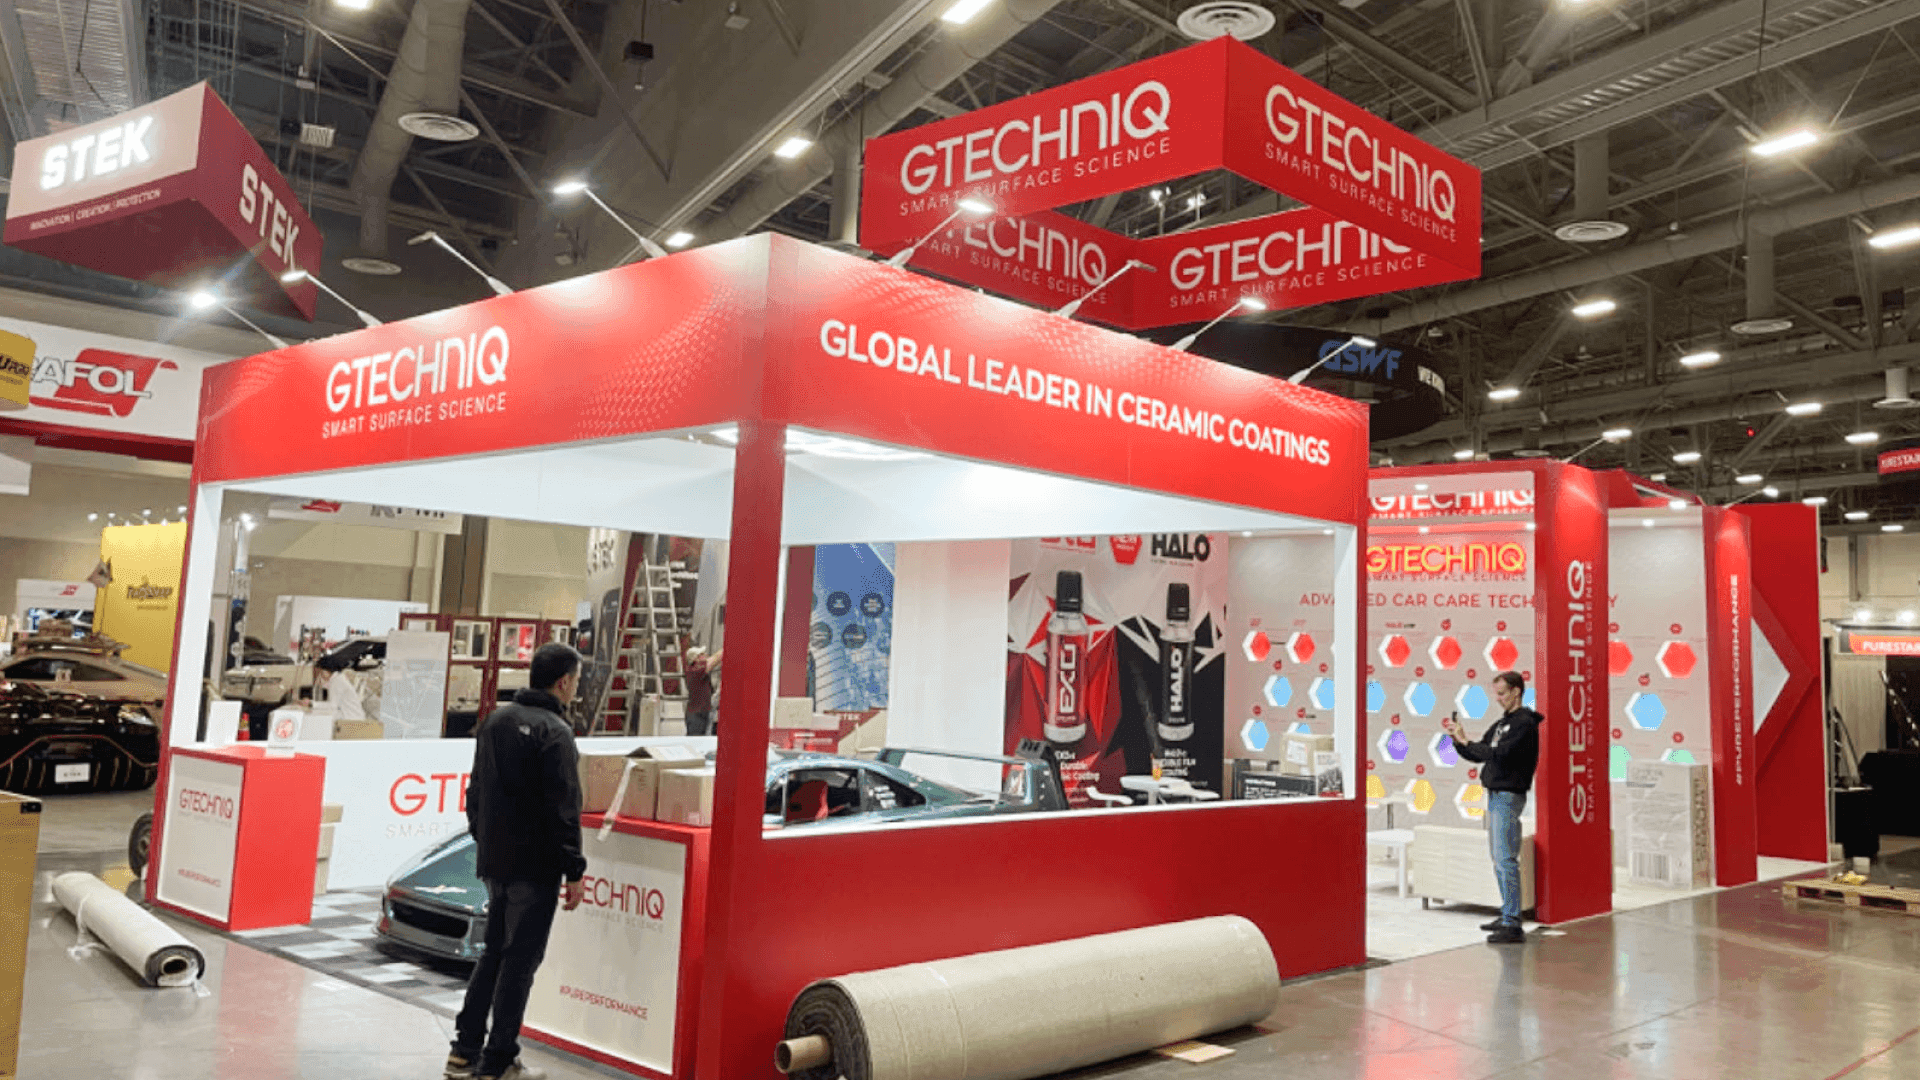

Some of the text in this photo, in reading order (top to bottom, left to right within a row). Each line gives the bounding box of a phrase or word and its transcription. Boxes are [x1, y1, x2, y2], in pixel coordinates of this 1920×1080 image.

[40, 113, 154, 191] STEK
[901, 81, 1170, 194] GTECHNIQ
[1266, 85, 1456, 223] GTECHNIQ
[900, 188, 961, 216] SMART
[1074, 137, 1171, 177] SCIENCE
[1265, 142, 1457, 242] SMART SURFACE SCIENCE
[239, 163, 299, 265] STEK
[947, 217, 1107, 286] ECHNIQ
[970, 251, 1040, 286] SURFACE
[1170, 254, 1427, 308] SMART SURFACE SCIENCE
[326, 326, 509, 413] GTECHNIQ
[820, 319, 1331, 466] GLOBAL LEADER IN CERAMIC COATINGS
[322, 392, 507, 440] SMART SURFACE SCIENCE
[1152, 533, 1211, 562] HALO
[1366, 543, 1526, 573] GTECHNIQ
[1392, 592, 1428, 607] CAR
[1433, 592, 1481, 608] CARE
[1059, 643, 1076, 713] EXO
[1170, 647, 1183, 713] HALO
[1567, 560, 1586, 824] GTECHNIQ
[179, 788, 234, 819] GTECHNIQ
[385, 821, 452, 839] SMART
